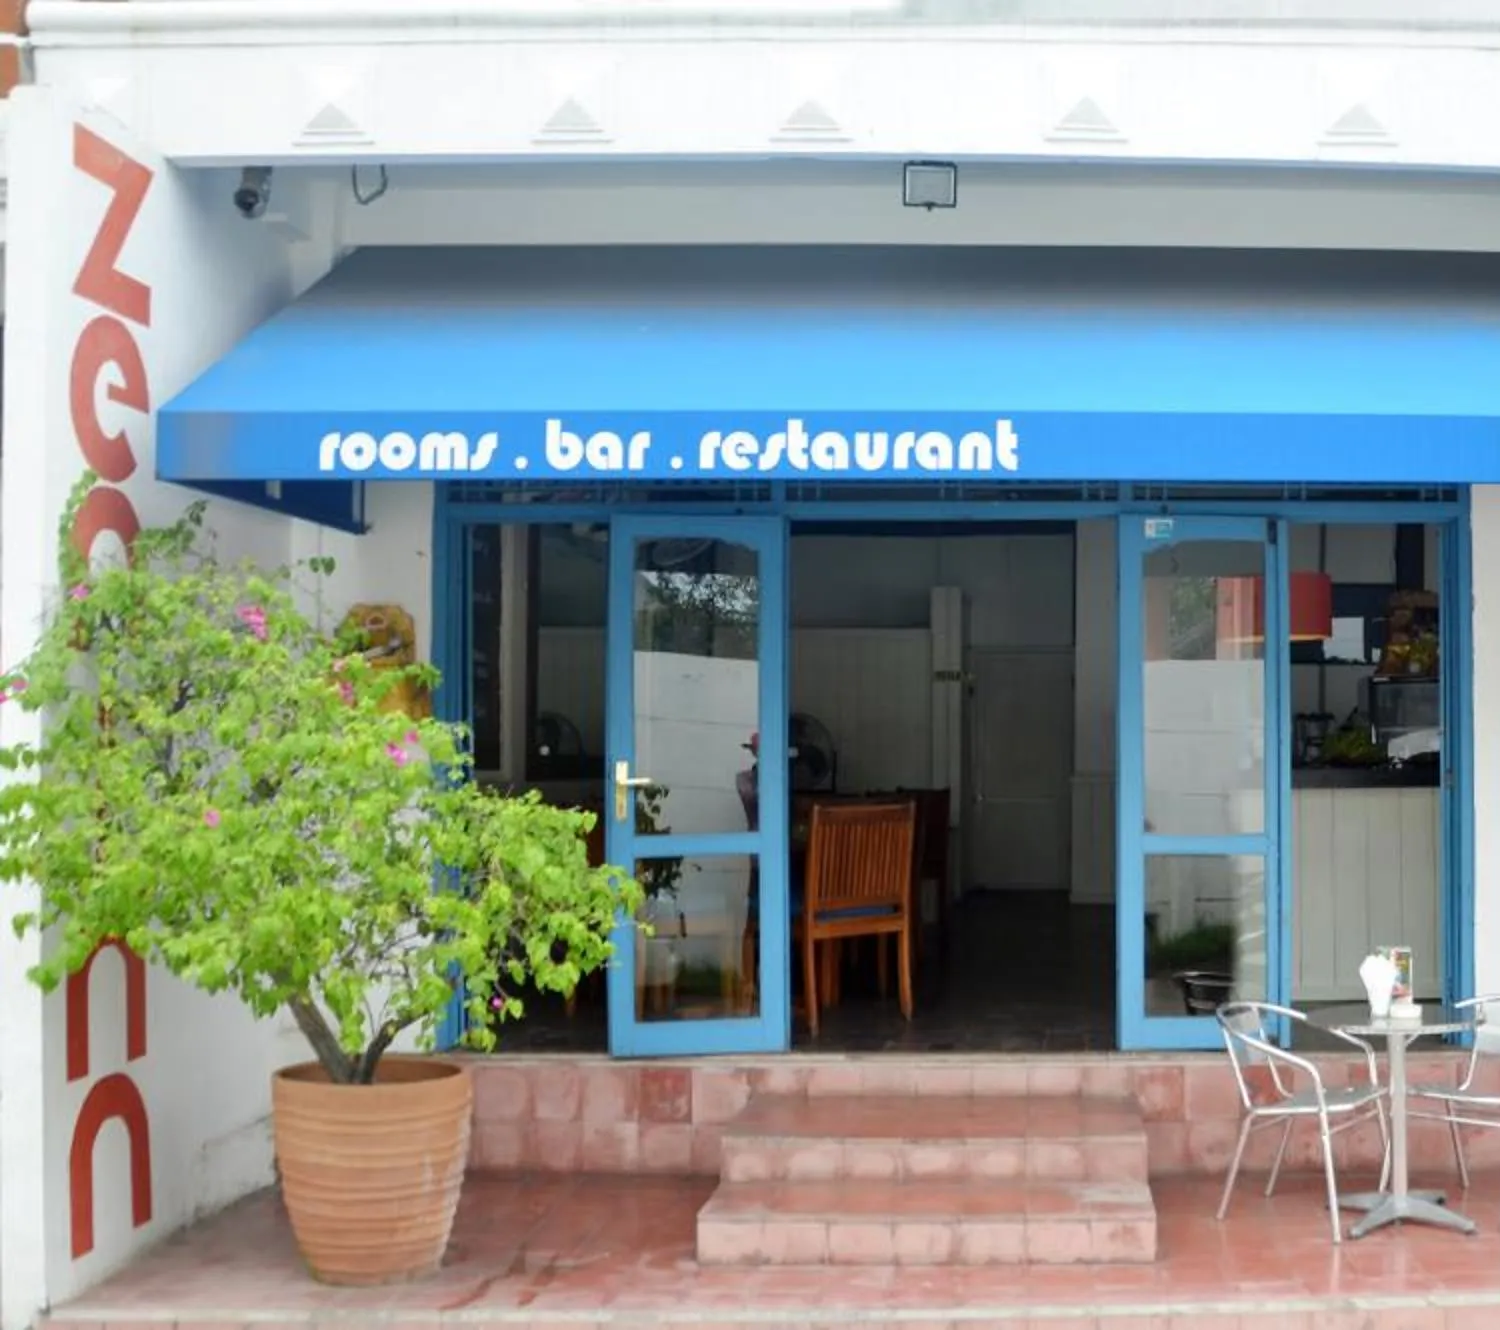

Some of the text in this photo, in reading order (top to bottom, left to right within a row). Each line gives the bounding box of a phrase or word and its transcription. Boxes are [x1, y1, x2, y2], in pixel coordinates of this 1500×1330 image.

[318, 430, 498, 472] rooms
[544, 417, 652, 472] bar
[698, 417, 1020, 472] restaurant
